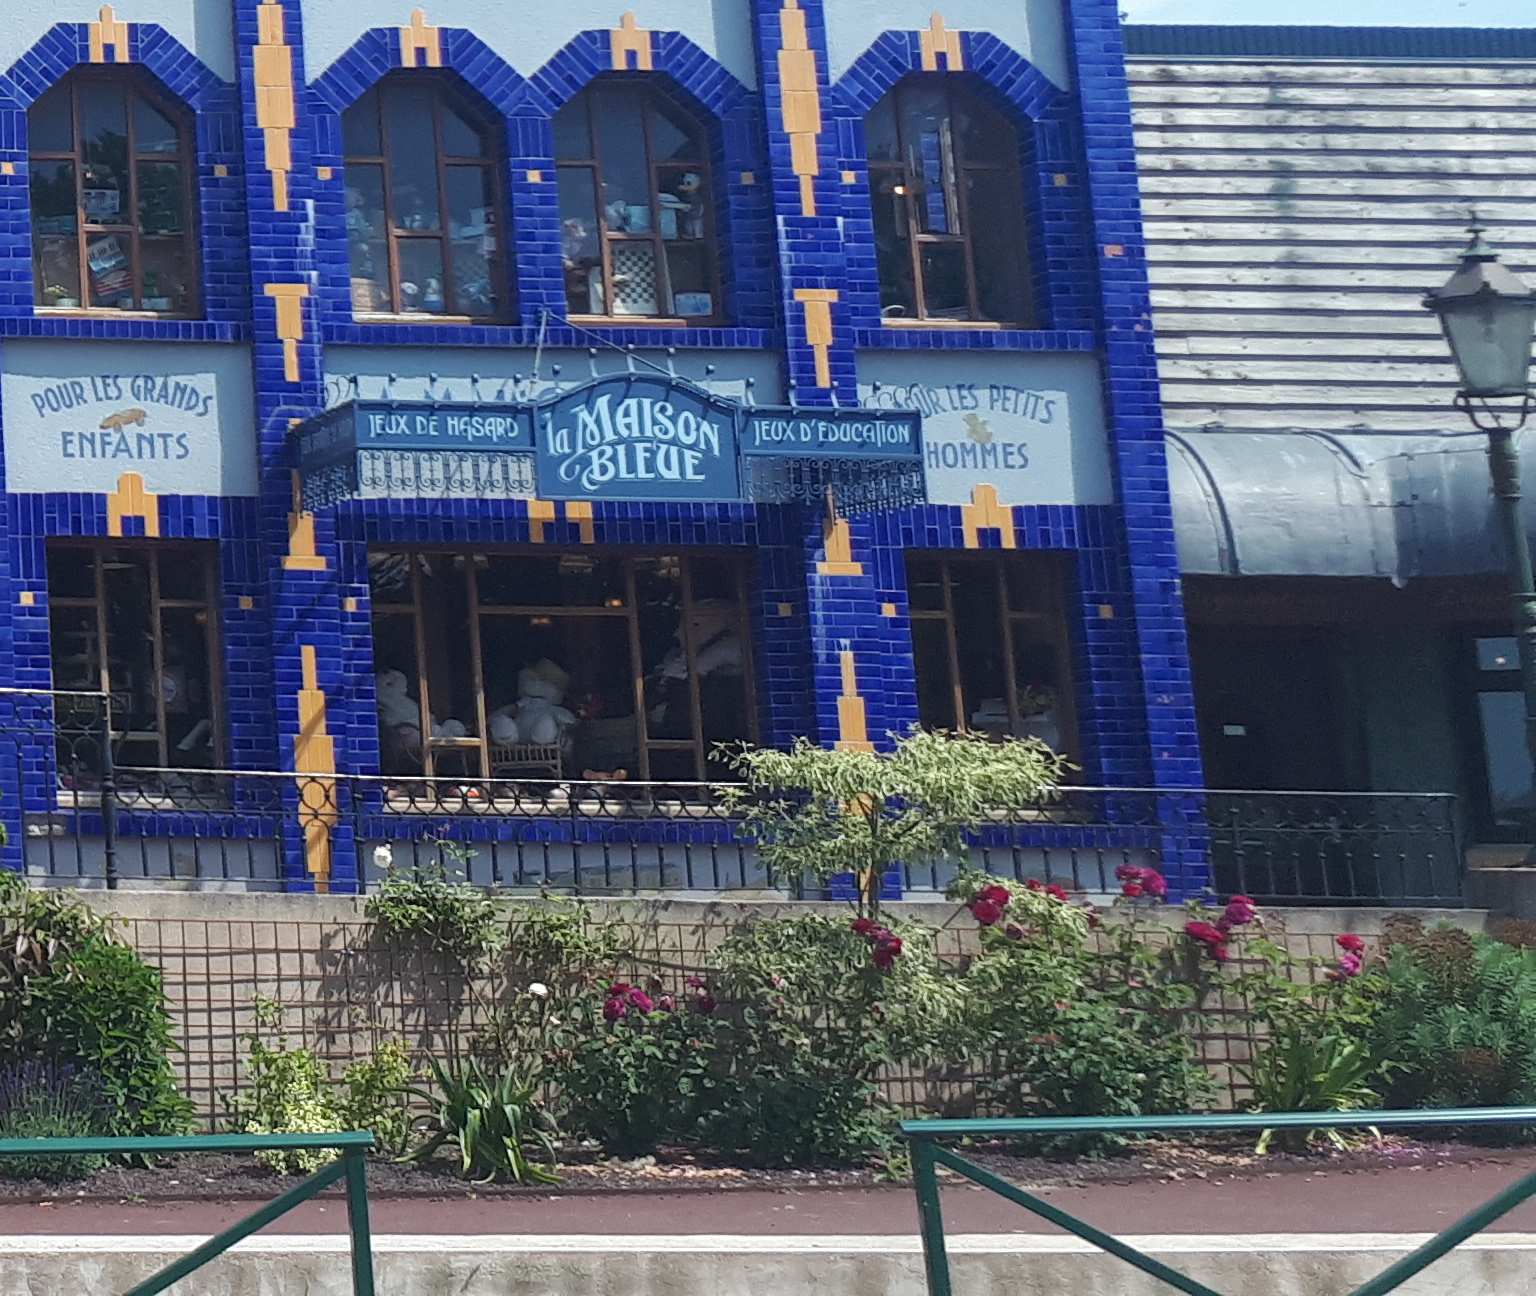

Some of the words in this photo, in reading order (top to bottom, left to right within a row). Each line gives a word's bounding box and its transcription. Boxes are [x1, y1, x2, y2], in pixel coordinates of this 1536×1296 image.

[30, 380, 88, 418] POUR
[90, 374, 123, 402] LES
[130, 373, 213, 417] GRANDS
[945, 383, 980, 411] LES
[988, 384, 1056, 424] PETITS
[61, 431, 190, 460] ENFANTS
[368, 414, 411, 438] JEUX
[415, 415, 439, 436] DE
[447, 415, 519, 442] HASARD
[559, 394, 721, 482] MAISON
[752, 419, 792, 446] JEUX
[581, 440, 706, 491] BLEUE
[926, 442, 1029, 469] HOMMES
